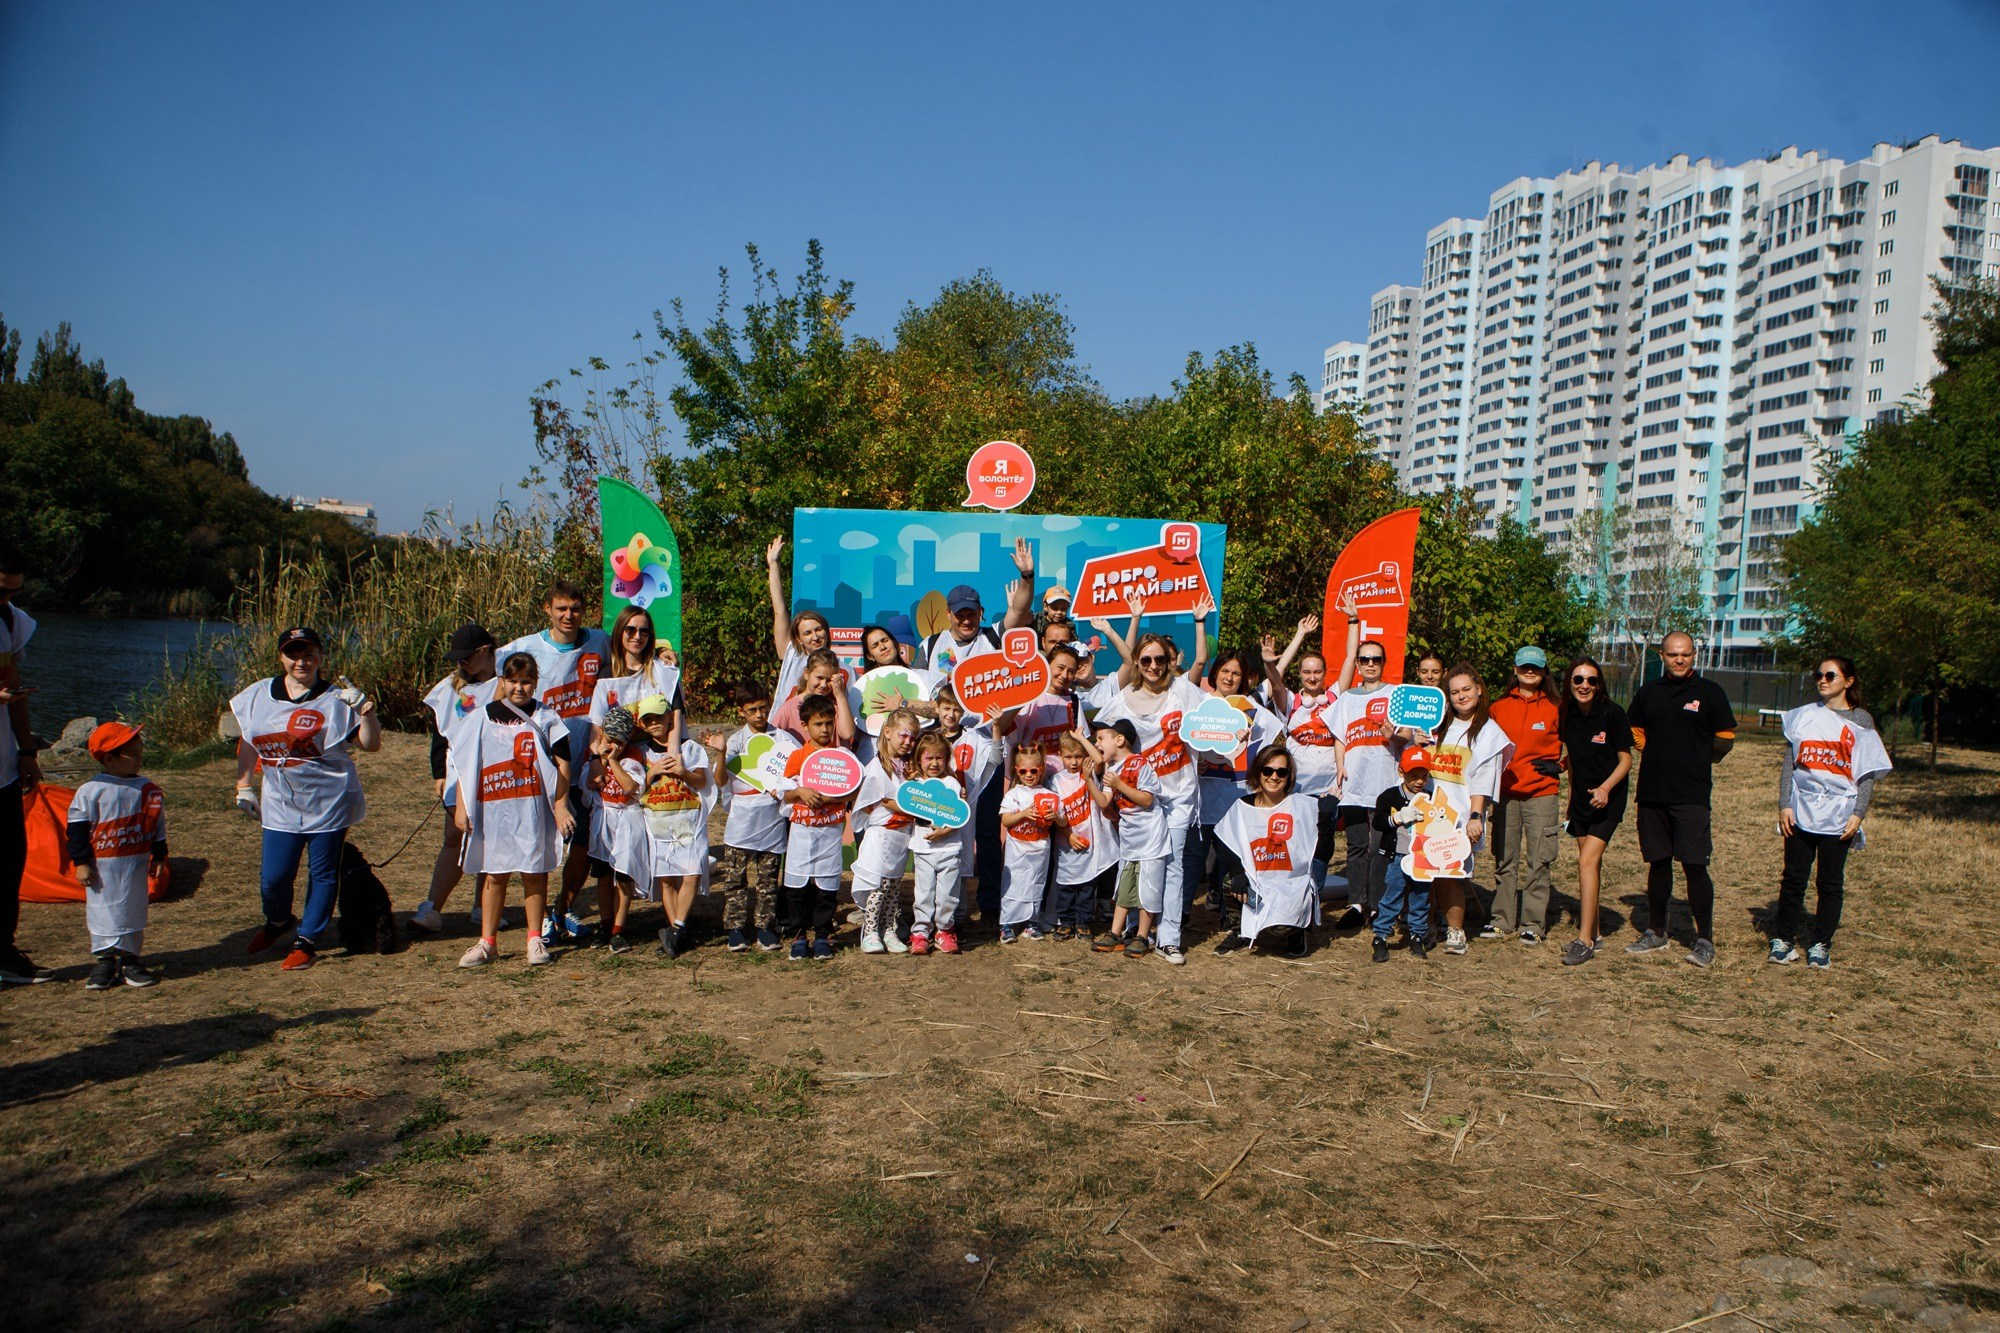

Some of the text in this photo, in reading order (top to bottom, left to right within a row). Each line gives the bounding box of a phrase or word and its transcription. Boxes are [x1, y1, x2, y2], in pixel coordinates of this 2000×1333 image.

[994, 460, 1007, 474] Я
[979, 475, 1024, 483] ВОЛОНТЁР
[1092, 565, 1157, 590] ДОБРО
[1092, 575, 1198, 604] НА РАЙОНЕ
[1346, 581, 1378, 594] ДОБРО
[1360, 587, 1397, 599] РАЙОНЕ
[833, 631, 864, 639] МАГНИ
[964, 667, 1010, 688] ДОБРО
[964, 670, 1041, 699] НА РАЙОНЕ
[547, 690, 582, 706] ДОБРО
[564, 696, 591, 710] РАЙО
[1409, 695, 1438, 704] ПРОСТО
[1417, 704, 1437, 712] БЫТЬ
[1190, 716, 1239, 725] ПРИТЯГИВАЮ
[1403, 711, 1436, 720] ДОБРЫМ
[776, 752, 788, 762] ВМ
[1802, 747, 1837, 757] ДОБРО
[819, 757, 845, 766] ДОБРО
[1802, 755, 1851, 768] НА РАЙОН
[823, 765, 852, 775] РАЙОНЕ
[483, 770, 514, 786] ДОБРО
[821, 772, 847, 781] ДОБРО
[483, 775, 537, 794] НА РАЙОНЕ
[807, 777, 851, 789] НА ПЛАНЕТЕ
[907, 786, 933, 799] СДЕЛАЛ
[916, 803, 937, 815] ГУЛЯЙ
[937, 811, 961, 823] СМЕЛО!
[99, 824, 142, 840] ДОБРО
[97, 840, 115, 850] НА
[1256, 852, 1286, 861] АЙОНЕ
